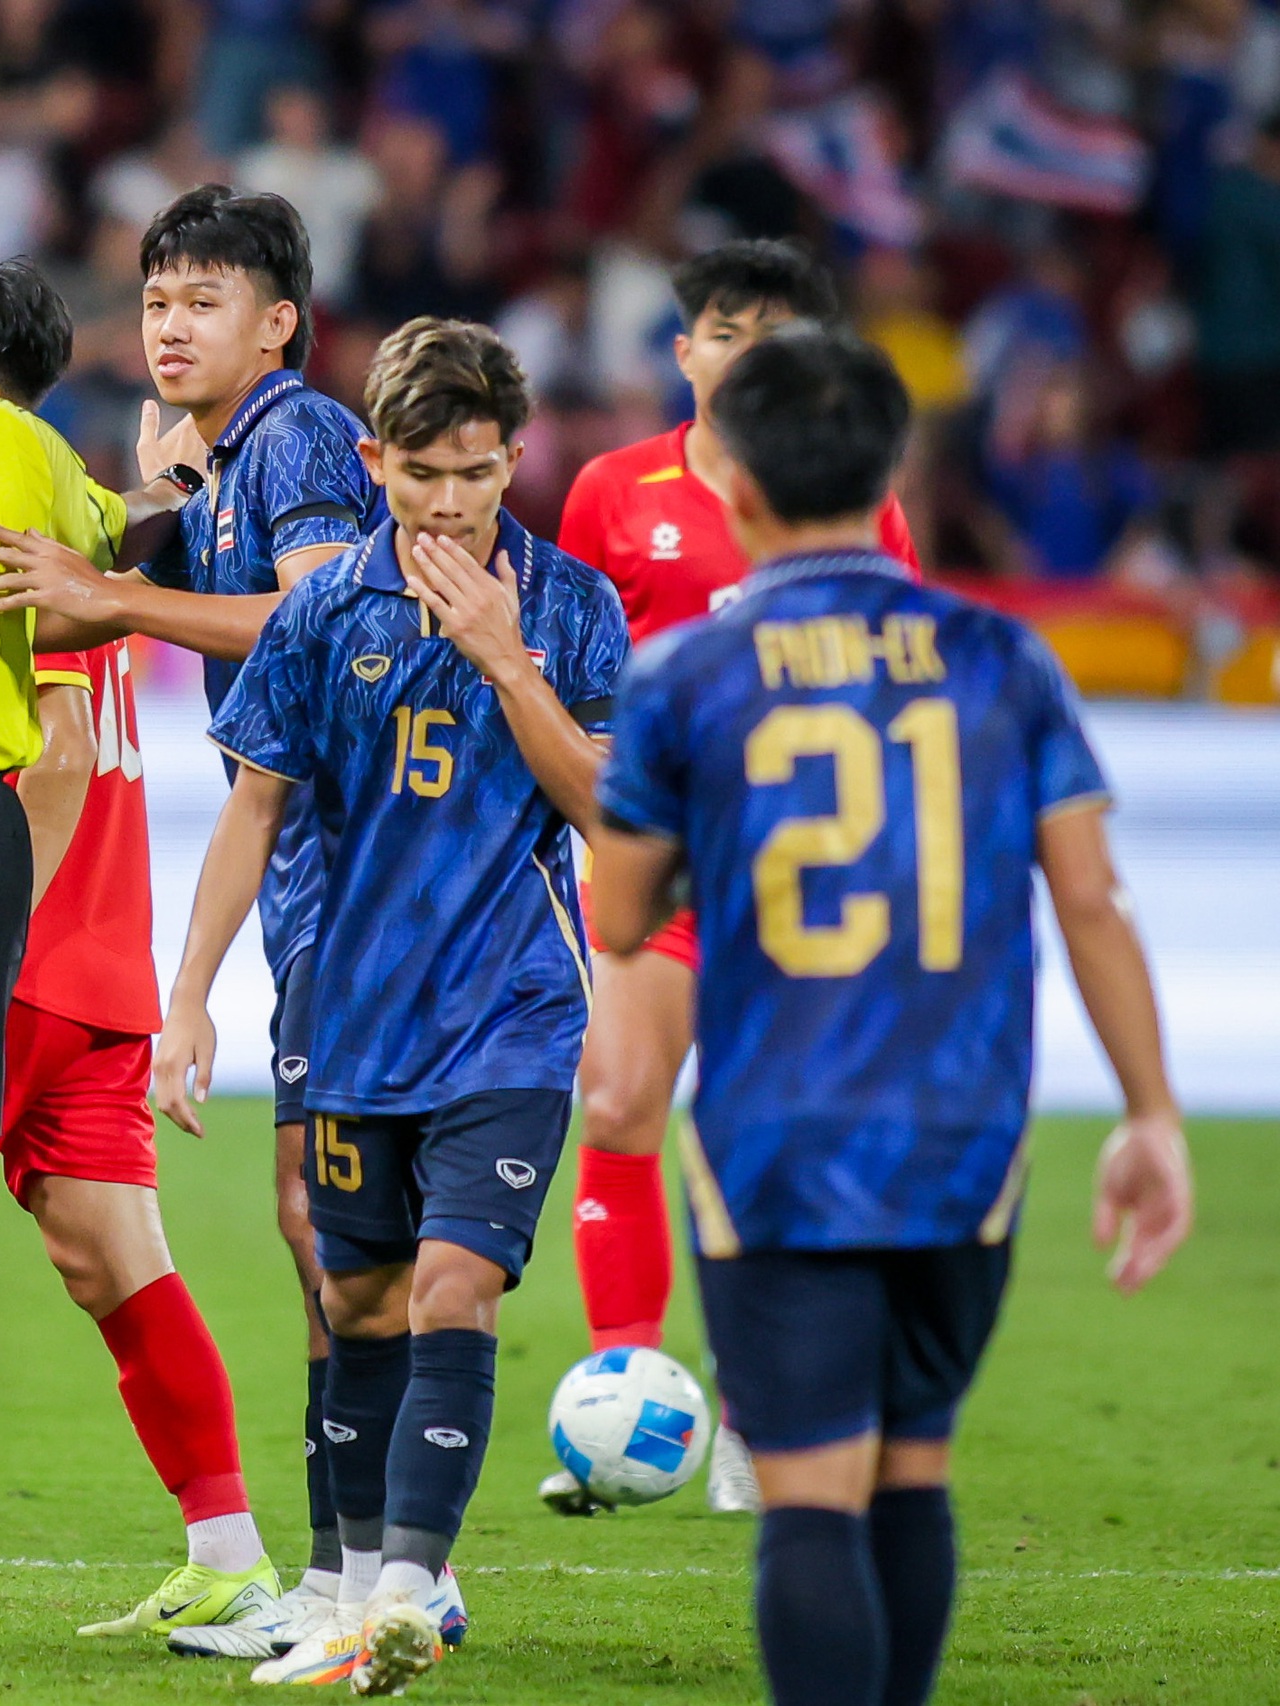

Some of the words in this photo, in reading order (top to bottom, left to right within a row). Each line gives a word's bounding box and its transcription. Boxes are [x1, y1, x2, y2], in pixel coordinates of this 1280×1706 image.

[391, 705, 456, 799] 15
[744, 698, 965, 978] 21
[315, 1113, 363, 1193] 15
